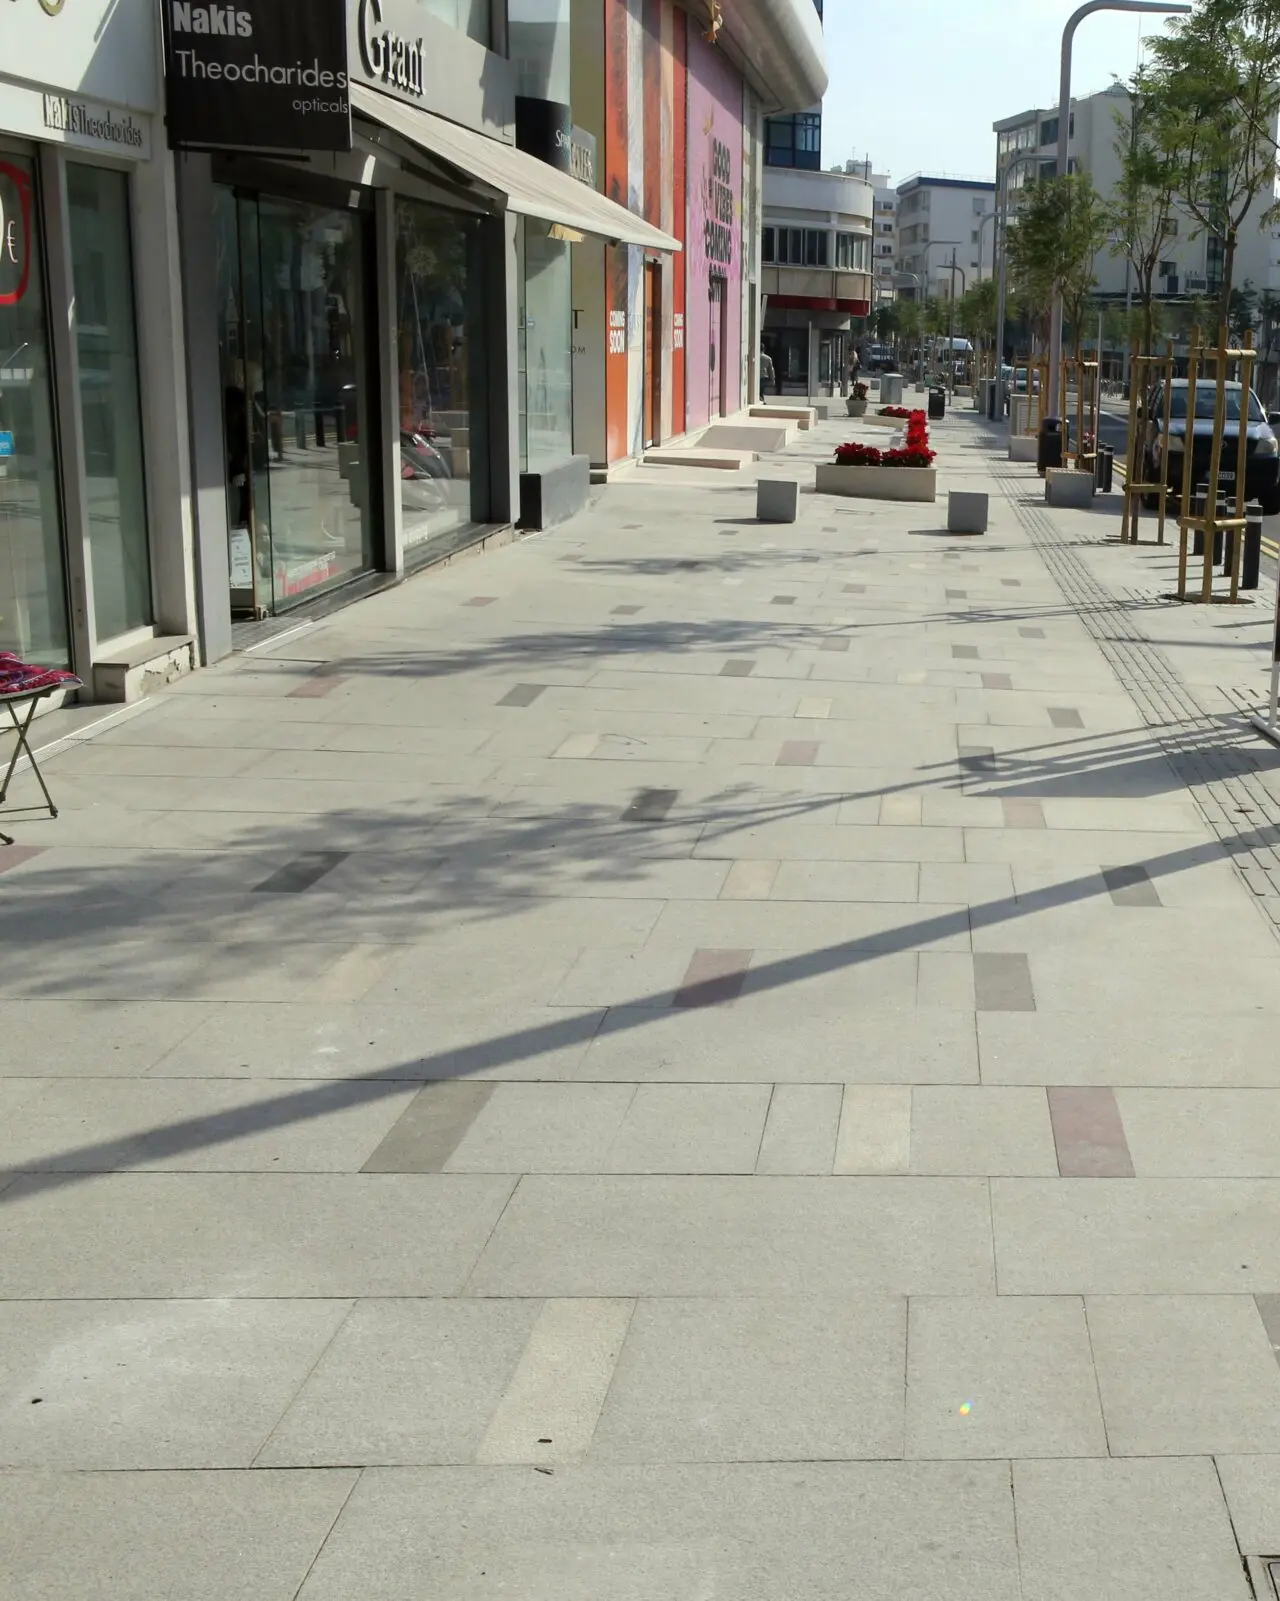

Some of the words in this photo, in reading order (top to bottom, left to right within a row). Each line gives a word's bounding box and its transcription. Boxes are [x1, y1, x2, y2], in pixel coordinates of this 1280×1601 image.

[172, 1, 253, 38] Nakis
[359, 0, 428, 98] Grant
[174, 50, 347, 90] Theocharides
[292, 97, 349, 116] opticals
[609, 329, 626, 354] SOON
